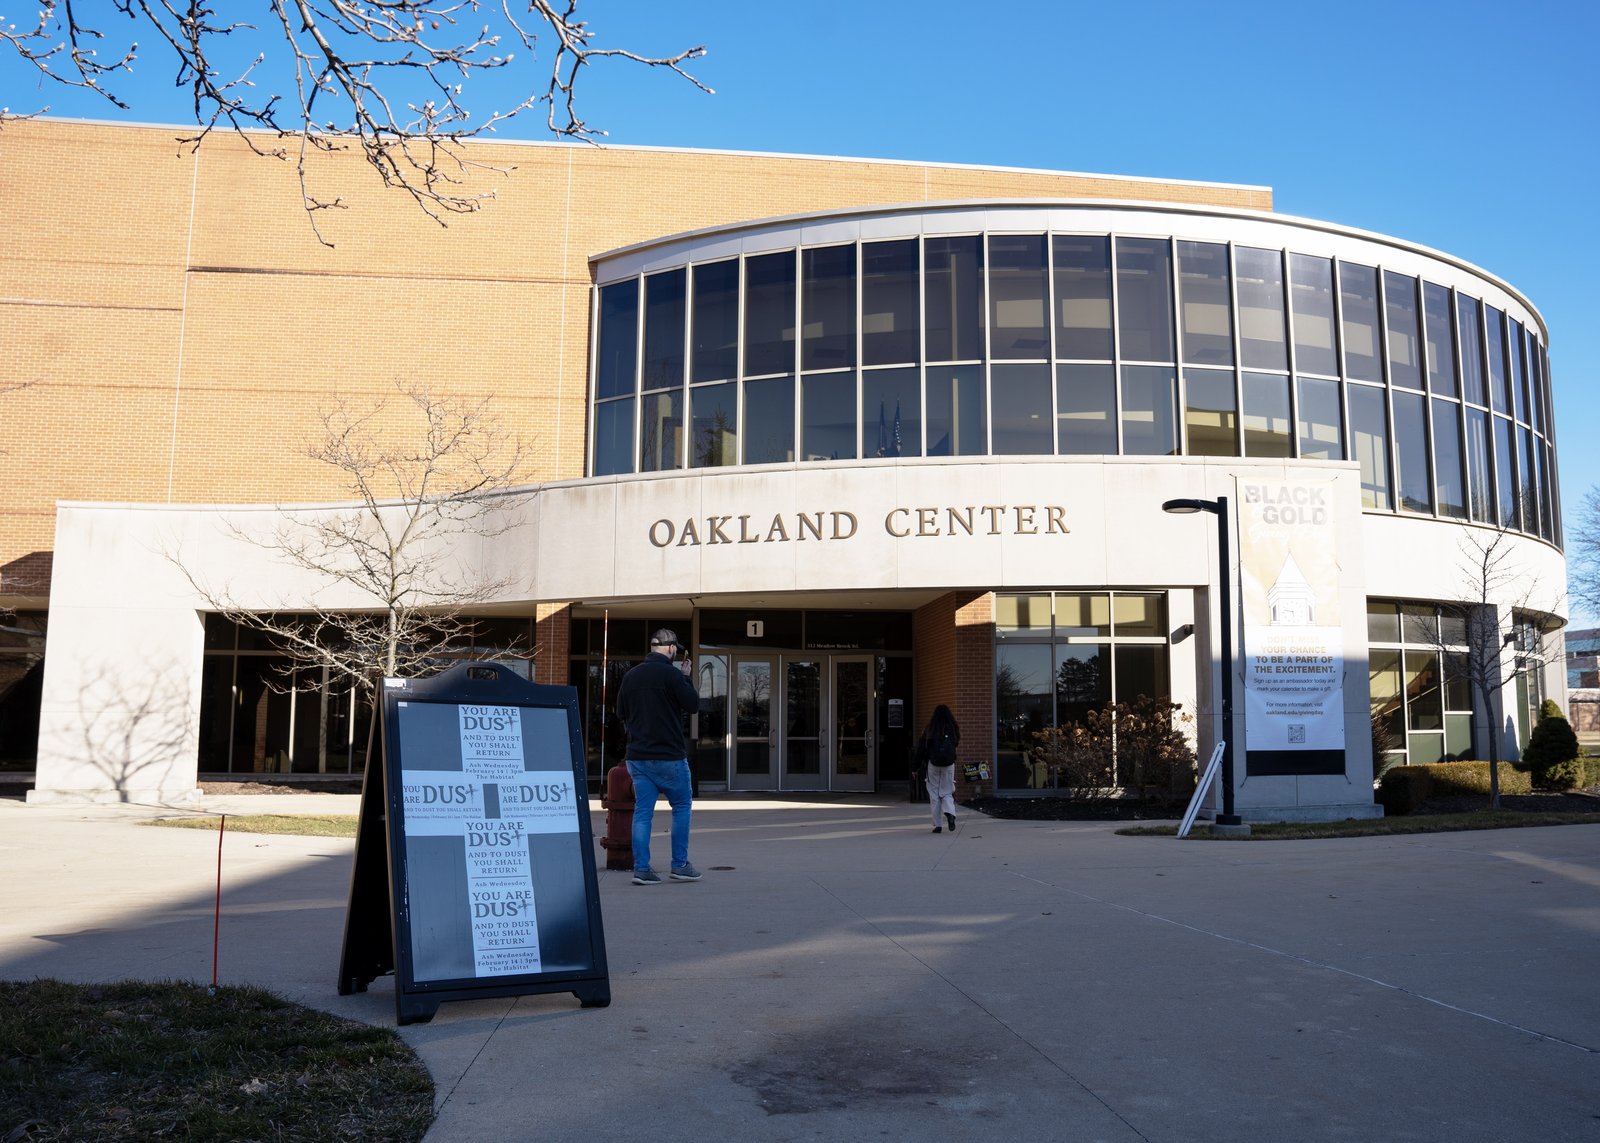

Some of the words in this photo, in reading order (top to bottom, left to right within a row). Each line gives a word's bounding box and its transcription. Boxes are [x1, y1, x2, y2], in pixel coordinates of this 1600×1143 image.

[1245, 486, 1326, 506] BLACK
[1262, 506, 1328, 525] GOLD
[649, 511, 858, 548] OAKLAND
[885, 505, 1070, 537] CENTER
[752, 622, 758, 636] 1
[462, 707, 488, 715] YOU
[493, 708, 518, 716] ARE
[499, 822, 524, 830] ARE
[472, 892, 500, 901] YOU
[506, 891, 531, 899] ARE
